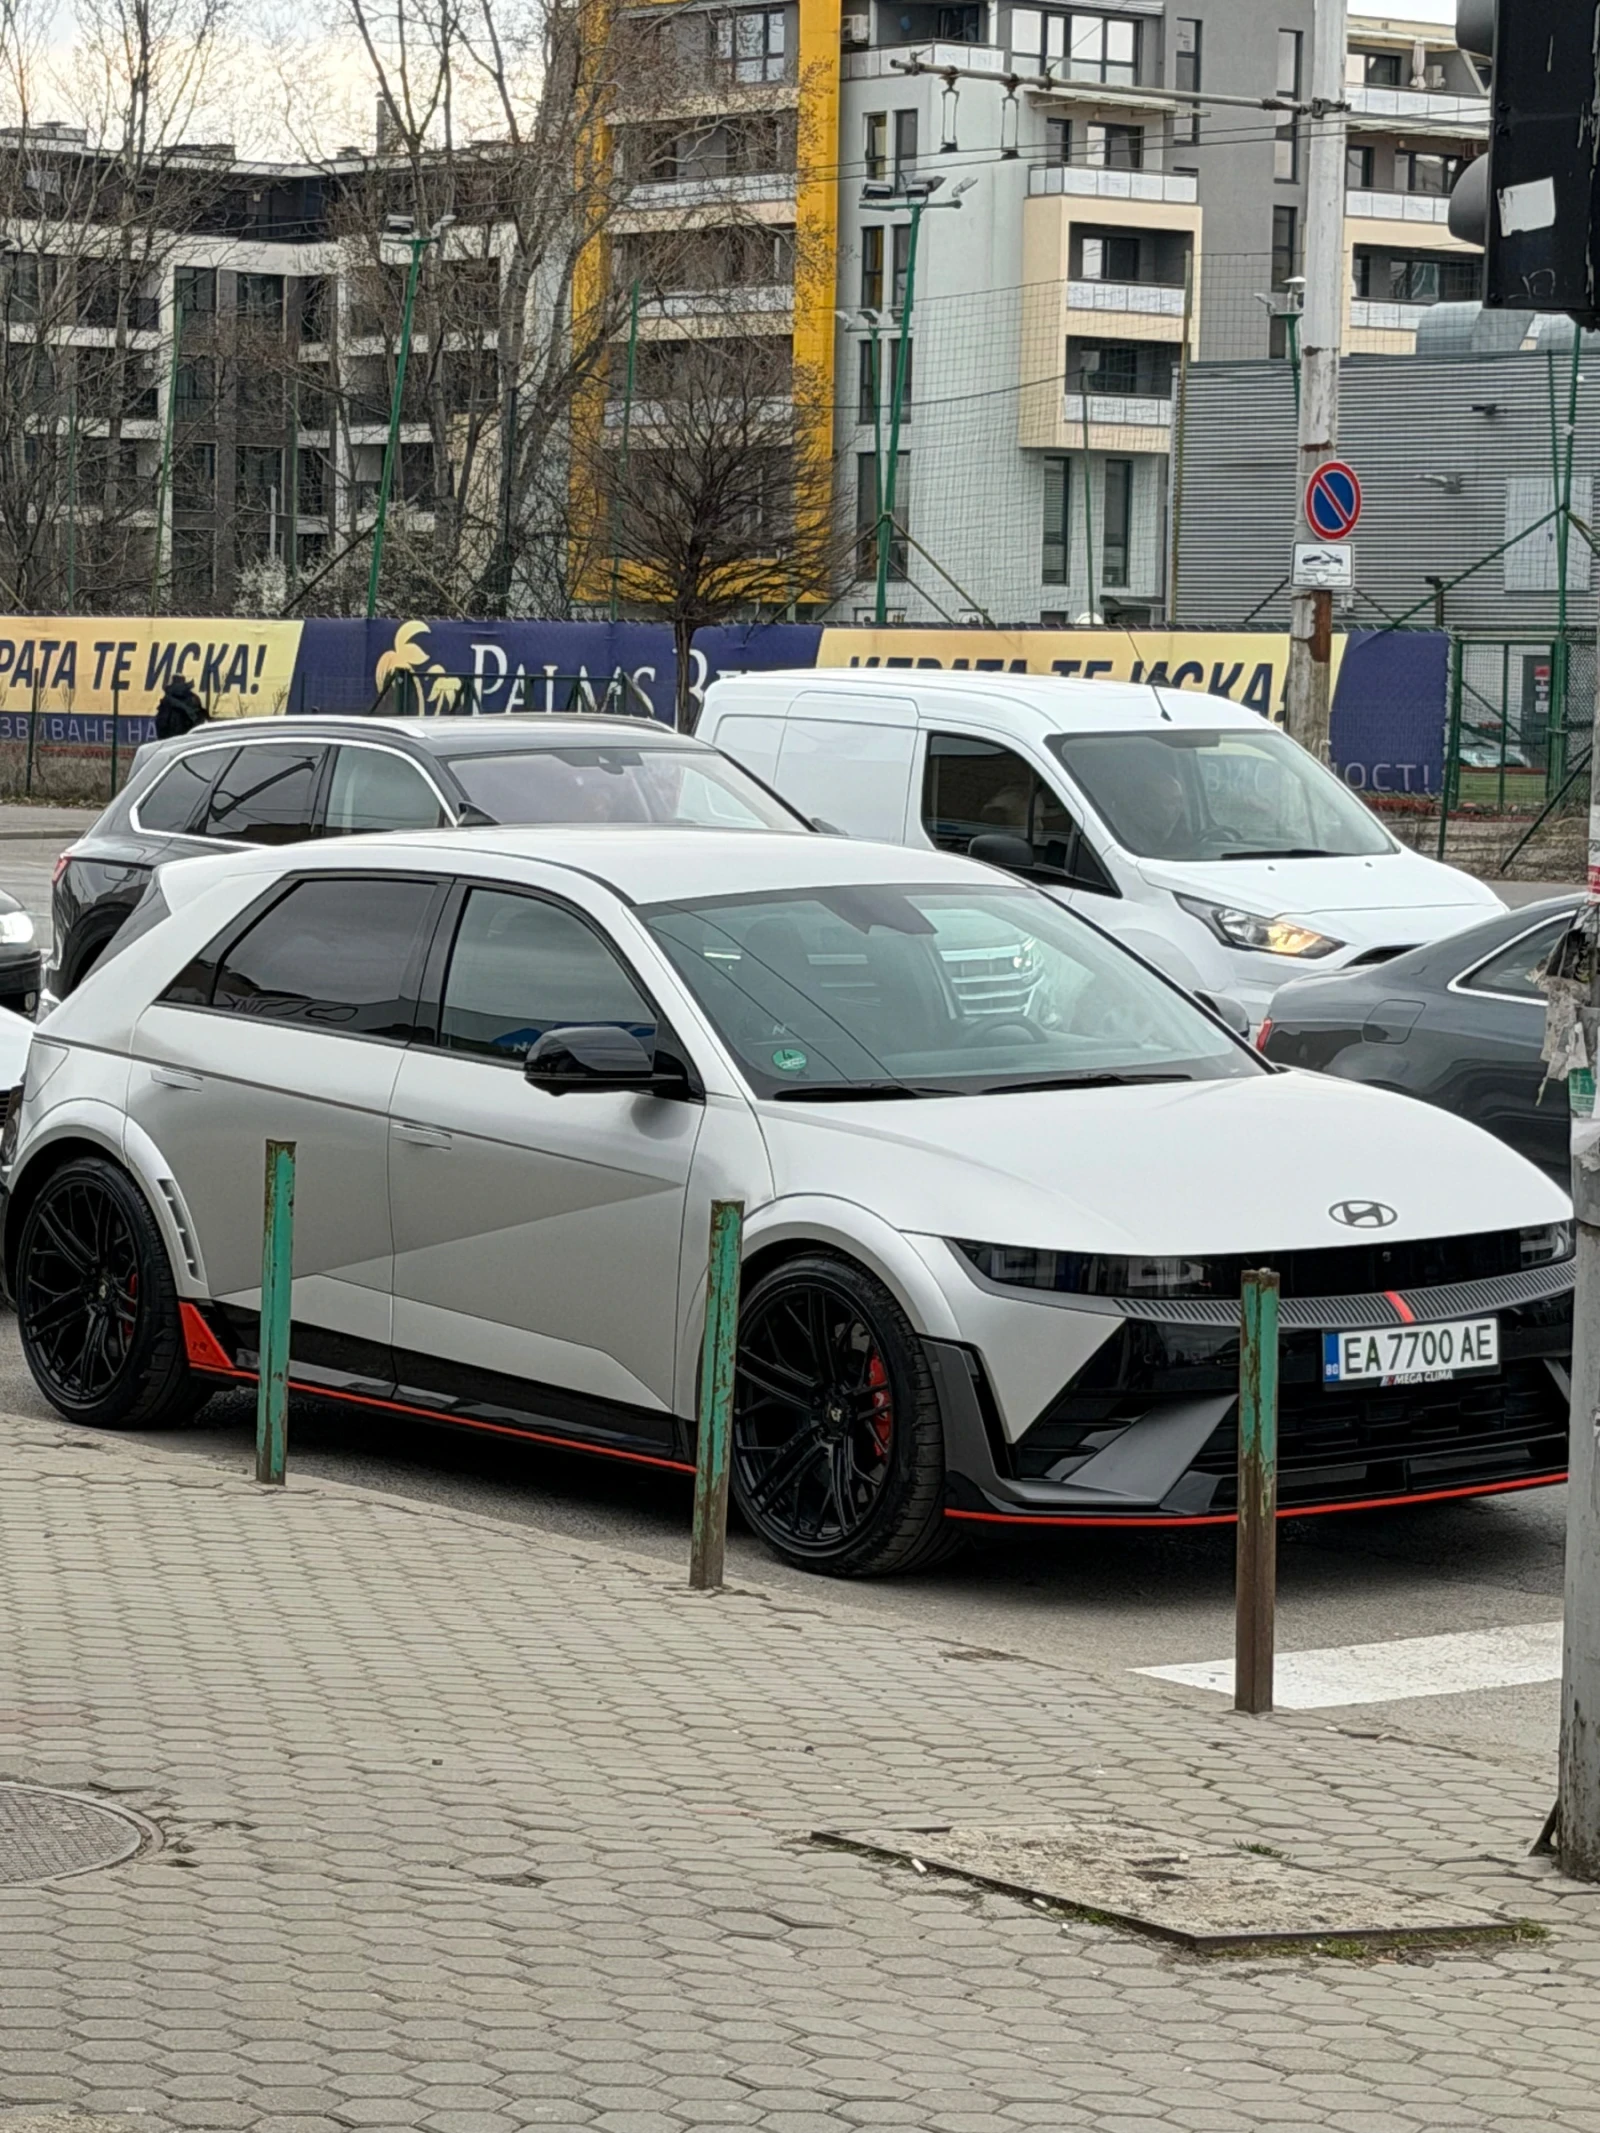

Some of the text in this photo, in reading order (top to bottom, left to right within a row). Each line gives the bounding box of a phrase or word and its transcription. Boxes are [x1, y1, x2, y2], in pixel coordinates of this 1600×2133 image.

[93, 641, 137, 690] ТЕ
[144, 641, 267, 695] ИСКА!
[0, 716, 114, 743] ЗВВАНЕ
[1333, 762, 1430, 792] ОСТ!
[1344, 1324, 1493, 1375] EA 7700 AE
[1325, 1364, 1339, 1375] BG
[1395, 1373, 1423, 1385] MEGA
